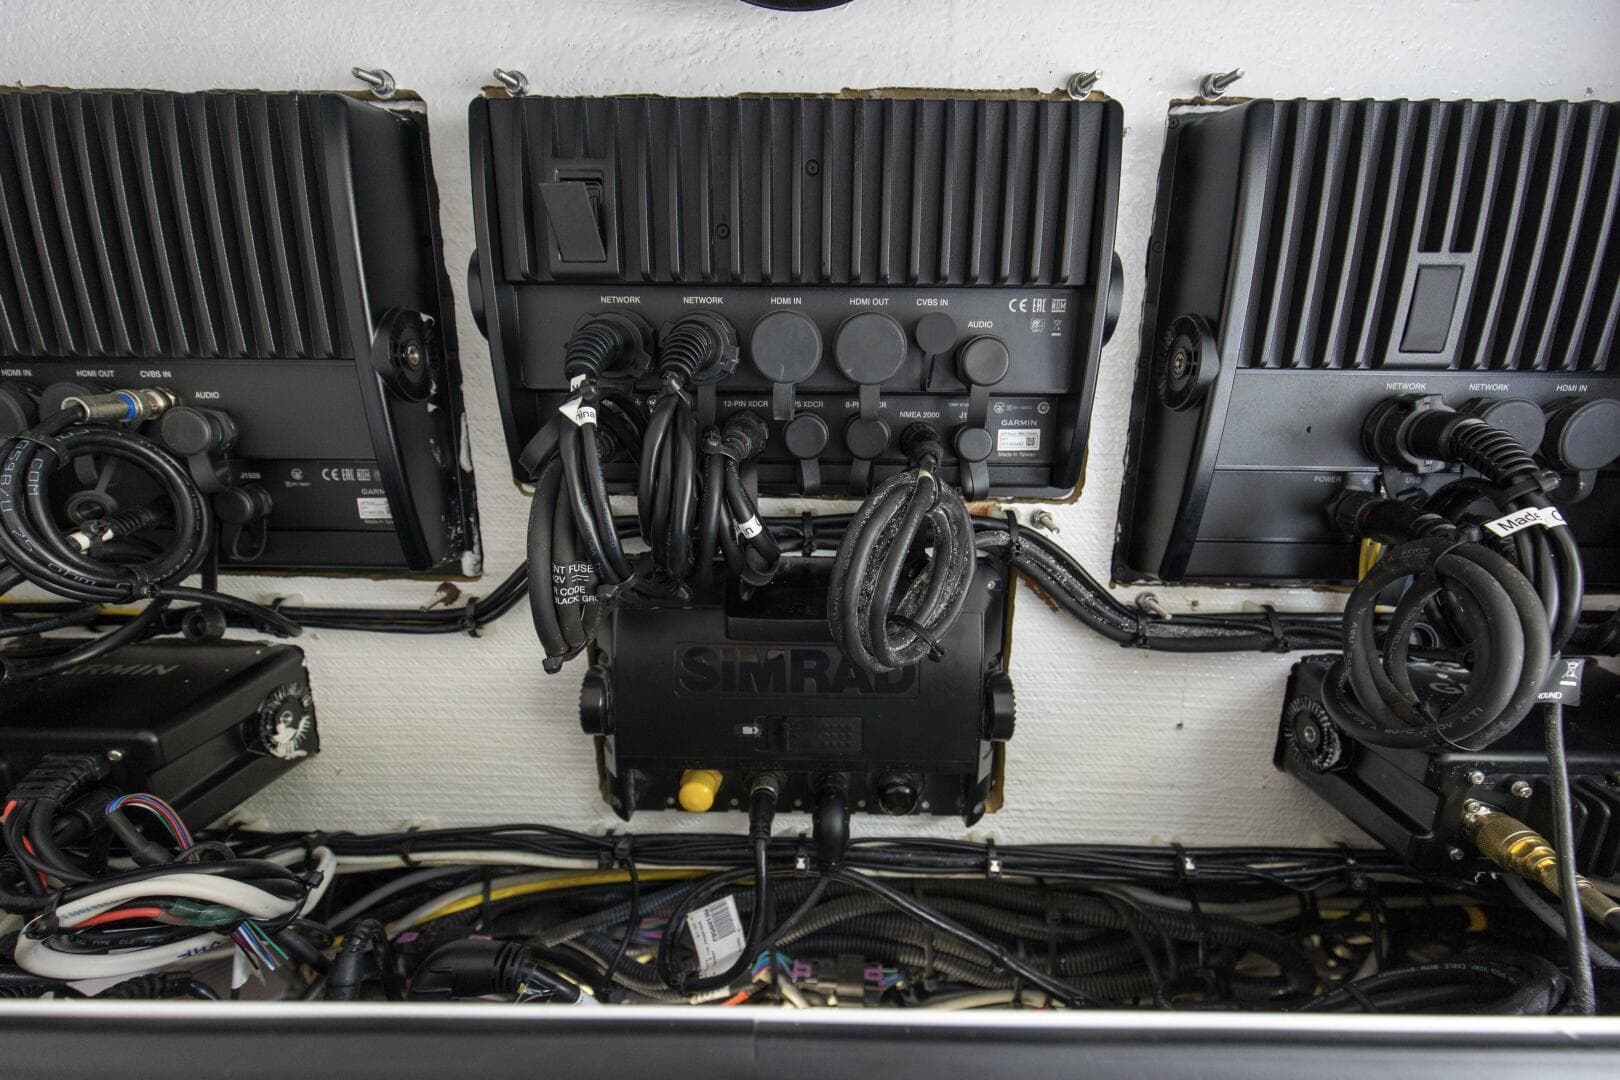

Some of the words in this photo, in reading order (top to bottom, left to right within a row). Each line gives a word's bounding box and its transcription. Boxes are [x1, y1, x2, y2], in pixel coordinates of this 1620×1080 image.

[600, 296, 641, 304] NETWORK
[683, 296, 724, 304] NETWORK
[770, 296, 792, 305] HDMI
[793, 297, 802, 305] IN
[849, 298, 871, 306] HDMI
[872, 298, 890, 306] OUT
[916, 298, 939, 306] CVBS
[939, 298, 949, 306] IN
[967, 320, 994, 329] AUDIO
[1, 369, 22, 377] HDMI
[23, 369, 33, 377] IN
[76, 370, 97, 378] HDMI
[98, 370, 115, 378] OUT
[140, 370, 162, 379] CVBS
[162, 370, 172, 379] IN
[1385, 382, 1428, 391] NETWORK
[1468, 383, 1510, 391] NETWORK
[1556, 384, 1577, 392] HDMI
[1577, 384, 1588, 392] IN
[195, 391, 220, 399] AUDIO
[723, 400, 747, 408] 12-PIN
[845, 401, 860, 409] 8-PI
[899, 411, 922, 419] NMEA
[922, 411, 940, 419] 2000
[568, 563, 594, 574] FUSE
[560, 585, 586, 596] CODE
